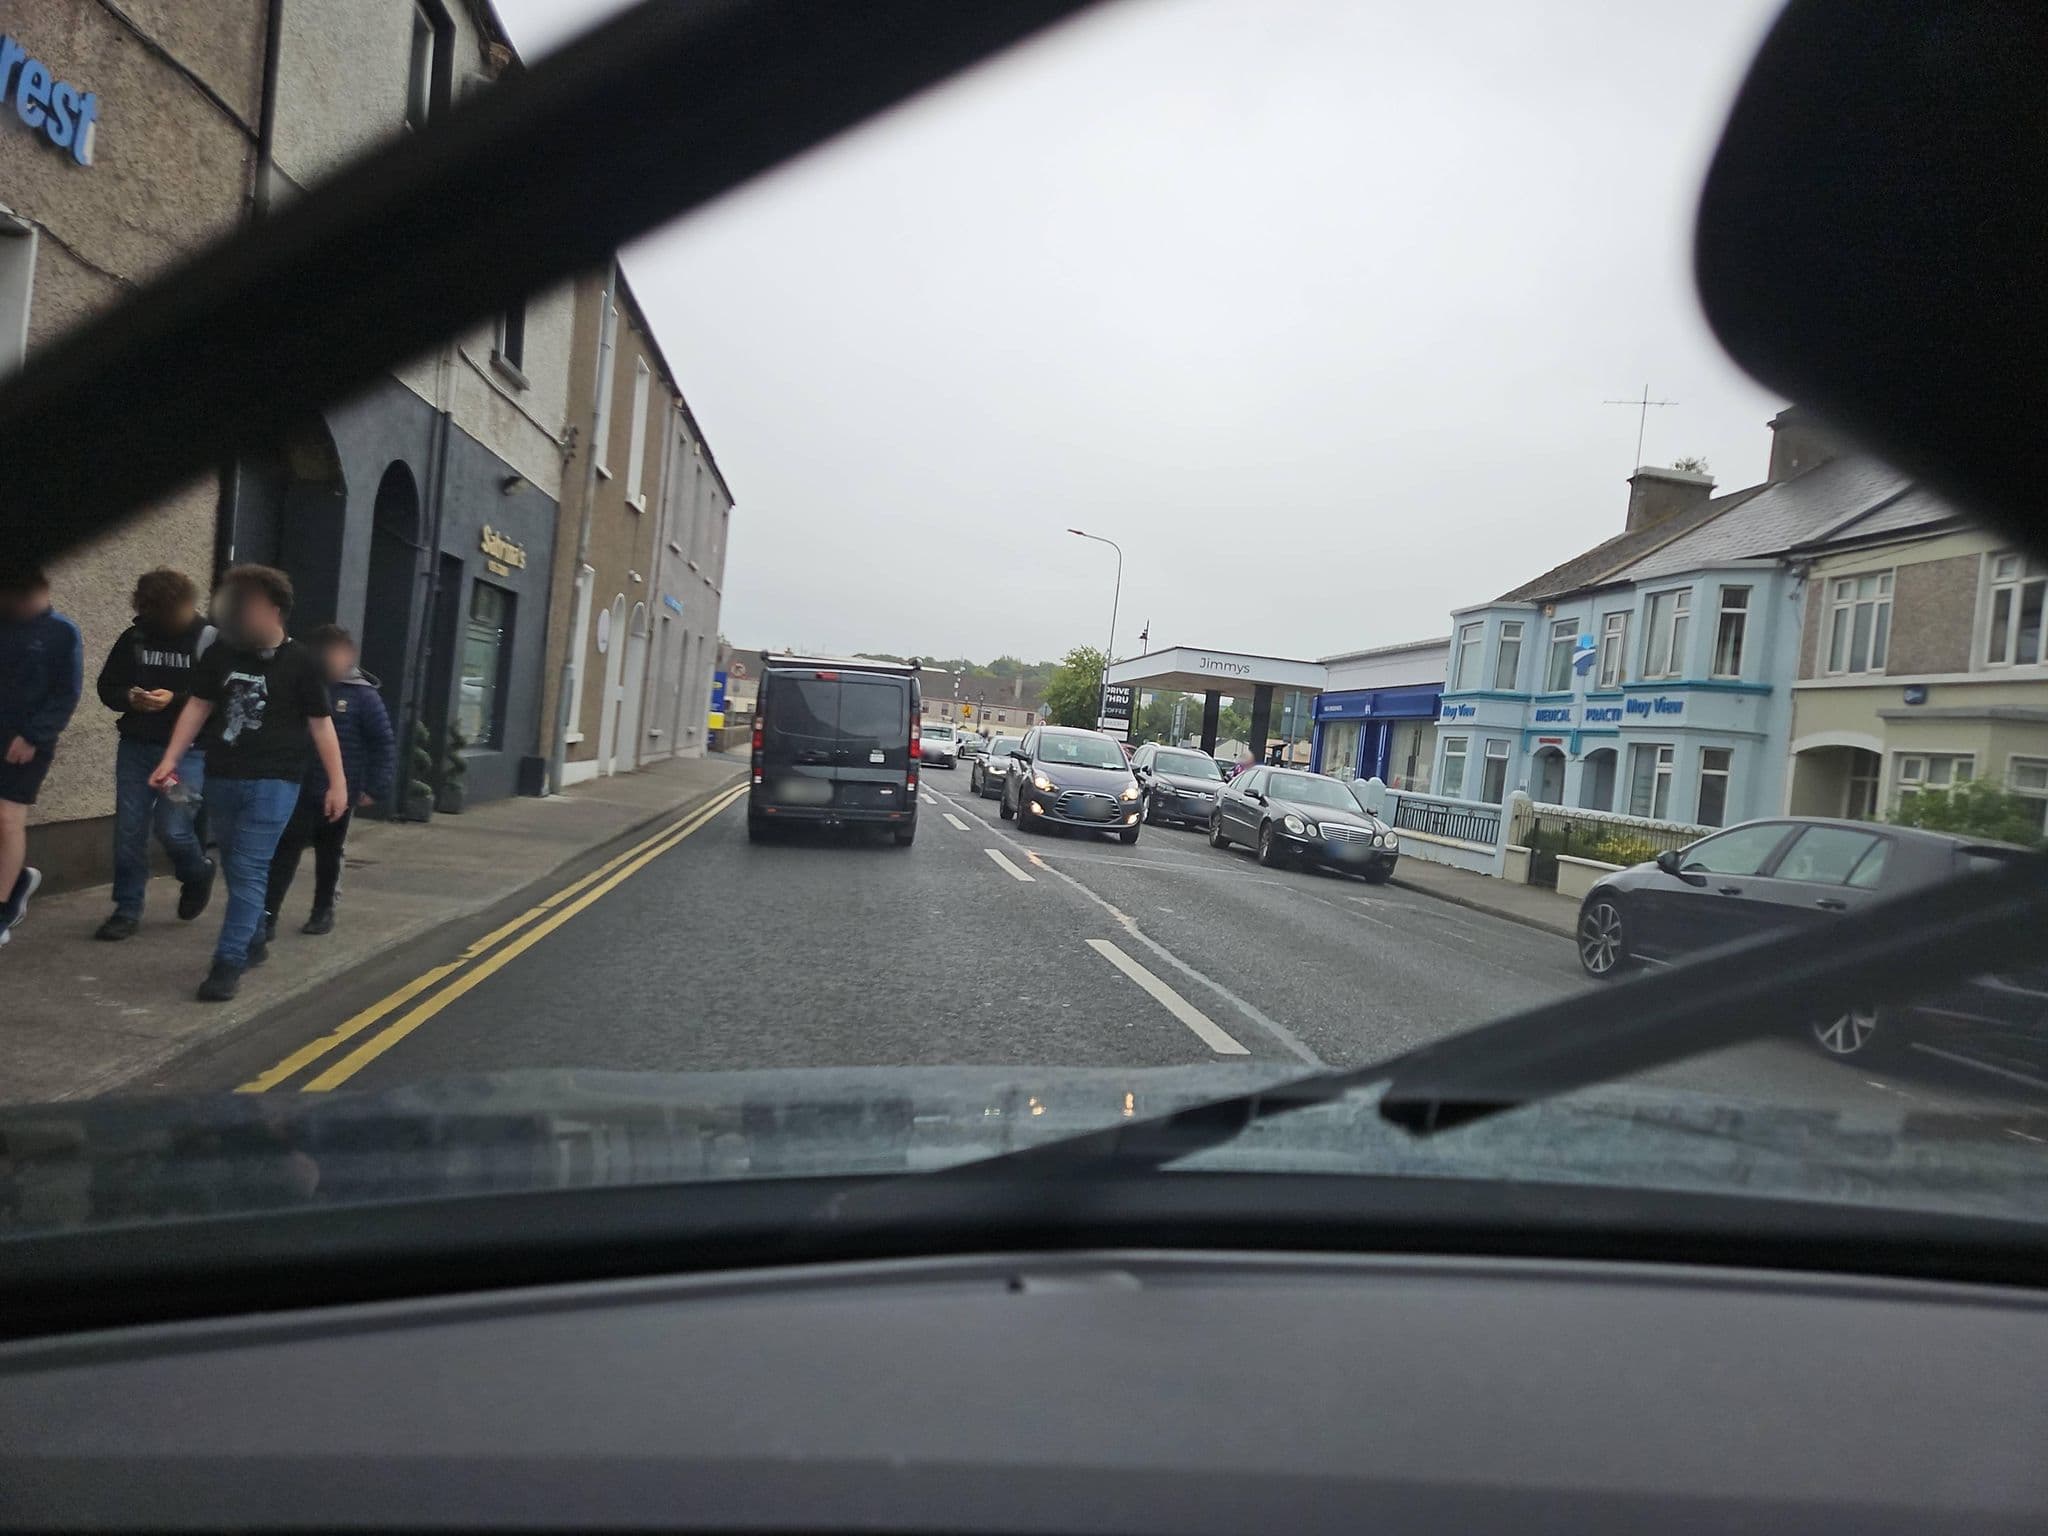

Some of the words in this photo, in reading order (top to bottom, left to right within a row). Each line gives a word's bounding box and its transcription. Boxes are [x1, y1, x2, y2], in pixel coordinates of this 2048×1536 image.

[143, 649, 190, 668] NIRVANA
[1200, 657, 1250, 675] Jimmys
[1535, 708, 1571, 722] MEDICAL
[1626, 698, 1651, 718] Moy
[1653, 696, 1684, 713] View
